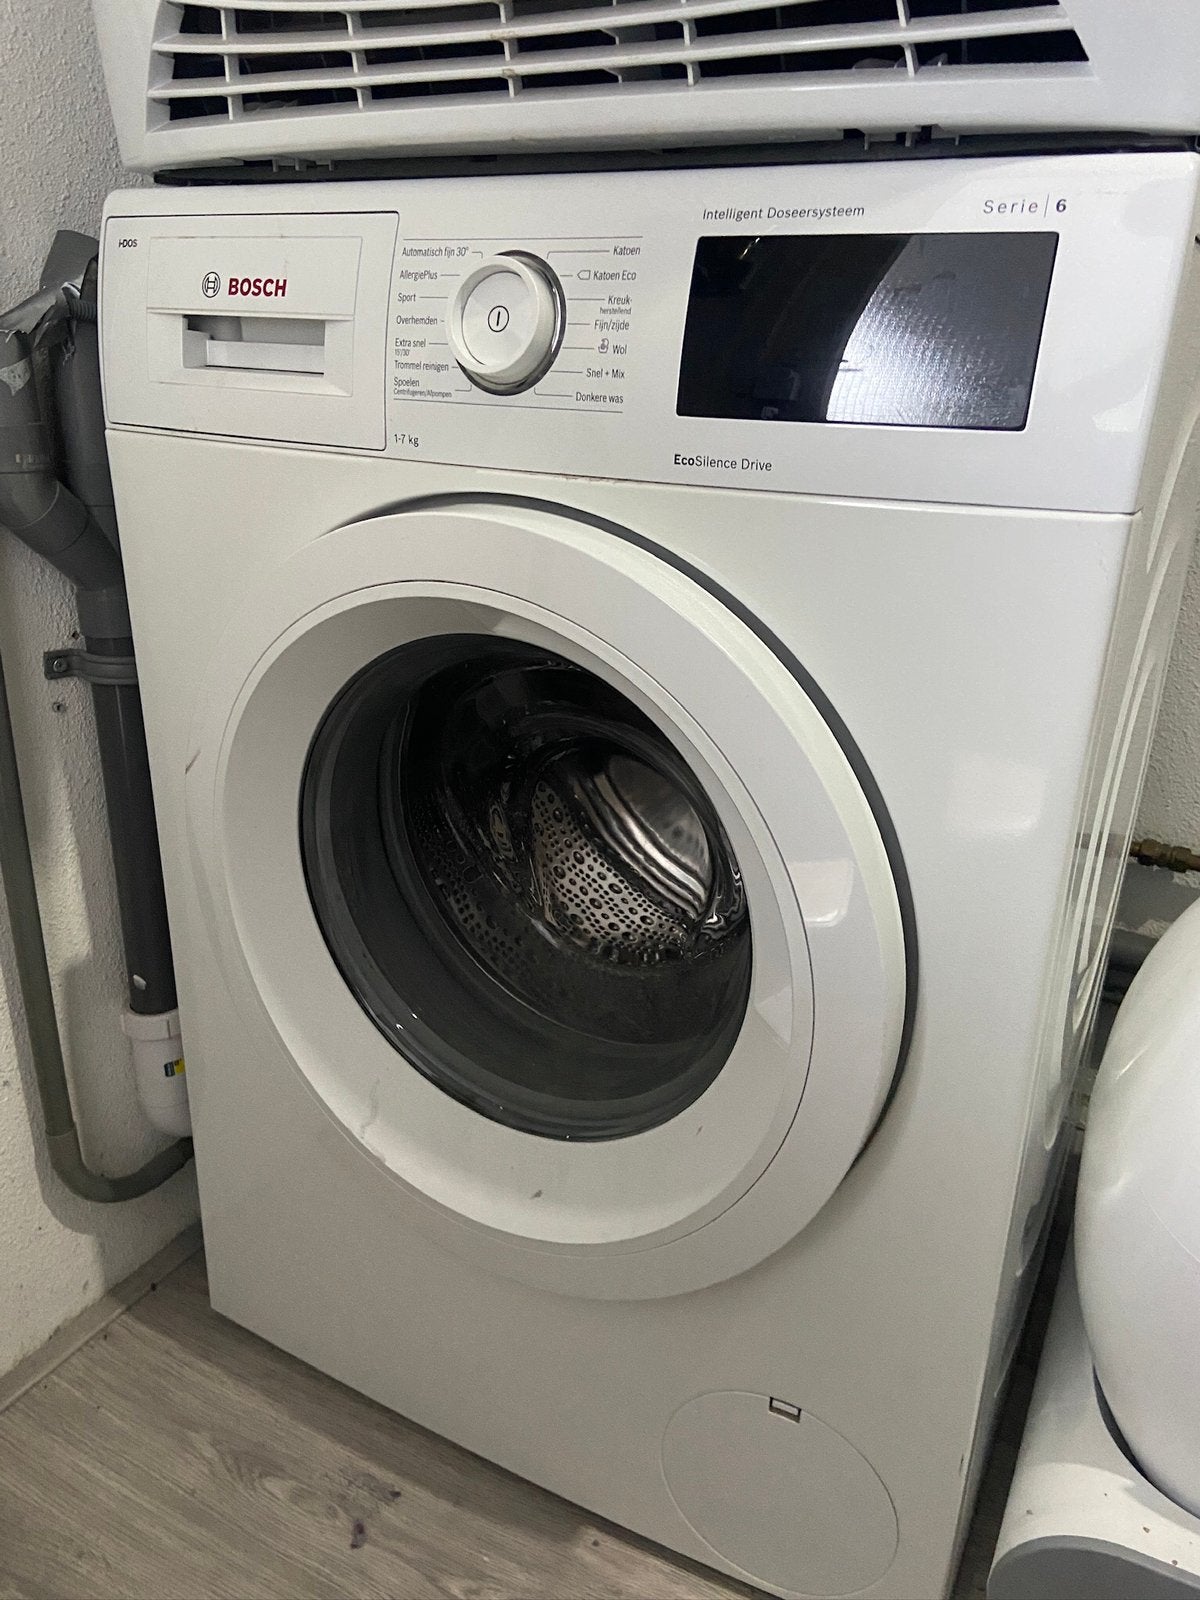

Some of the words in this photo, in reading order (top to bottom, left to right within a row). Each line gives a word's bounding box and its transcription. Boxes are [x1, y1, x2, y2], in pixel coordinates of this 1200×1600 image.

[983, 199, 1039, 214] Serie
[1056, 199, 1067, 213] 6
[702, 208, 763, 222] Intelligent
[767, 206, 865, 219] Doseersysteem
[402, 247, 443, 257] Automatisch
[444, 246, 455, 259] fijn
[613, 245, 641, 256] Katoen
[400, 270, 438, 281] AllergiePlus
[593, 270, 620, 281] Katoen
[621, 270, 637, 281] Eco
[228, 278, 287, 297] BOSCH
[397, 292, 416, 303] Sport
[599, 306, 632, 315] herstellend
[396, 315, 438, 326] Overhemden
[594, 319, 630, 332] Fijn/zijde
[394, 337, 412, 348] Extra
[412, 338, 427, 348] snel
[612, 344, 628, 355] Wol
[394, 359, 422, 370] Trommel
[422, 361, 449, 373] reinigen
[586, 367, 604, 379] Snel
[611, 368, 626, 379] Mix
[393, 376, 420, 388] Spoelen
[575, 391, 608, 403] Donkere
[608, 395, 624, 404] was
[394, 433, 406, 445] 1-7
[408, 434, 420, 448] kg
[673, 453, 738, 470] EcoSilence
[741, 458, 773, 472] Drive
